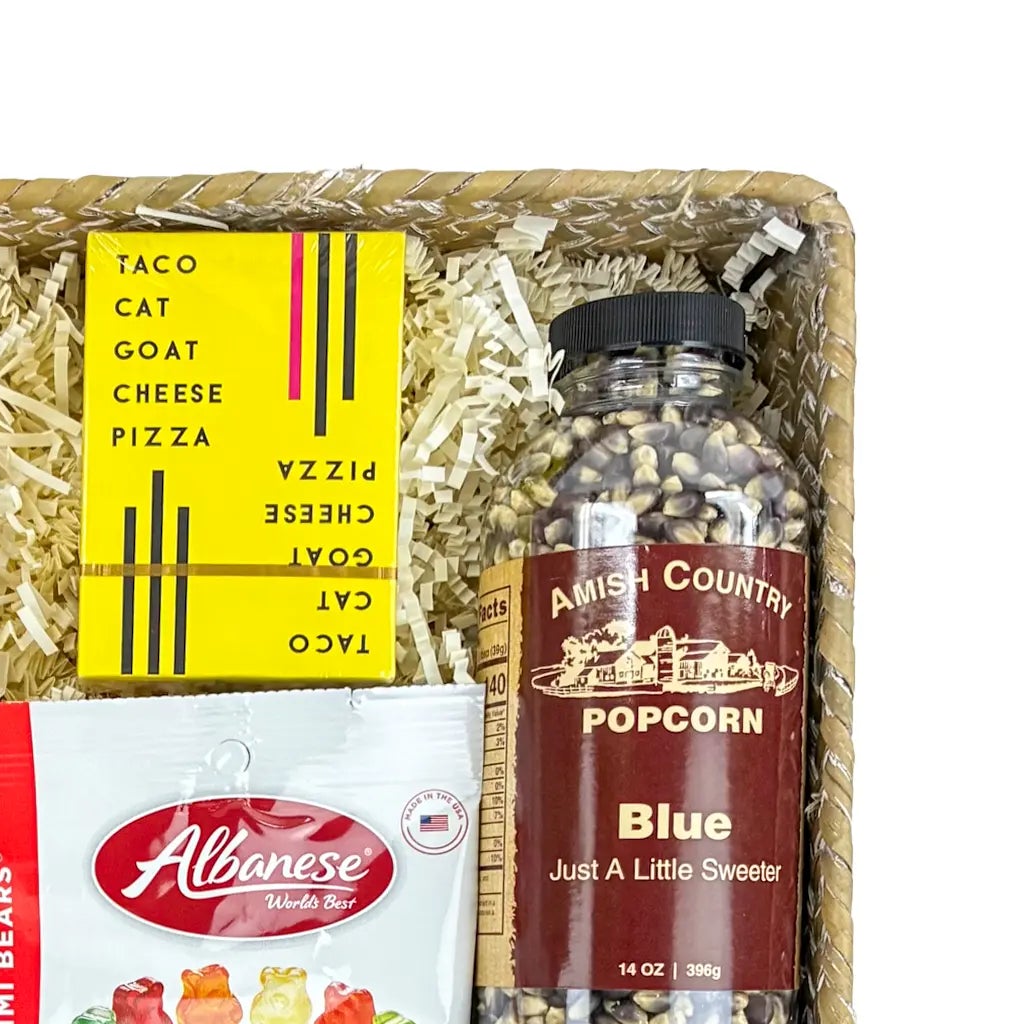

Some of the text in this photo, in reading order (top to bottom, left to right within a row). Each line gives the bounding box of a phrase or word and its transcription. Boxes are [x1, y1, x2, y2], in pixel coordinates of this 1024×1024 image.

[117, 254, 197, 275] TACO
[115, 297, 170, 318] CAT
[114, 340, 199, 361] GOAT
[113, 383, 222, 403] CHEESE
[112, 427, 210, 447] PIZZA
[278, 460, 376, 481] PIZZA
[264, 504, 374, 524] CHEESE
[289, 547, 374, 568] GOAT
[551, 559, 793, 620] AMISH COUNTRY
[317, 591, 372, 611] CAT
[289, 634, 370, 654] TACO
[582, 707, 763, 734] POPCORN
[404, 798, 423, 821] MADE
[436, 793, 453, 804] THE
[452, 802, 464, 820] USA
[618, 803, 732, 840] Blue
[550, 858, 782, 882] Just A Little Sweeter
[323, 893, 357, 910] Best
[618, 963, 721, 980] 14 OZ 396g
